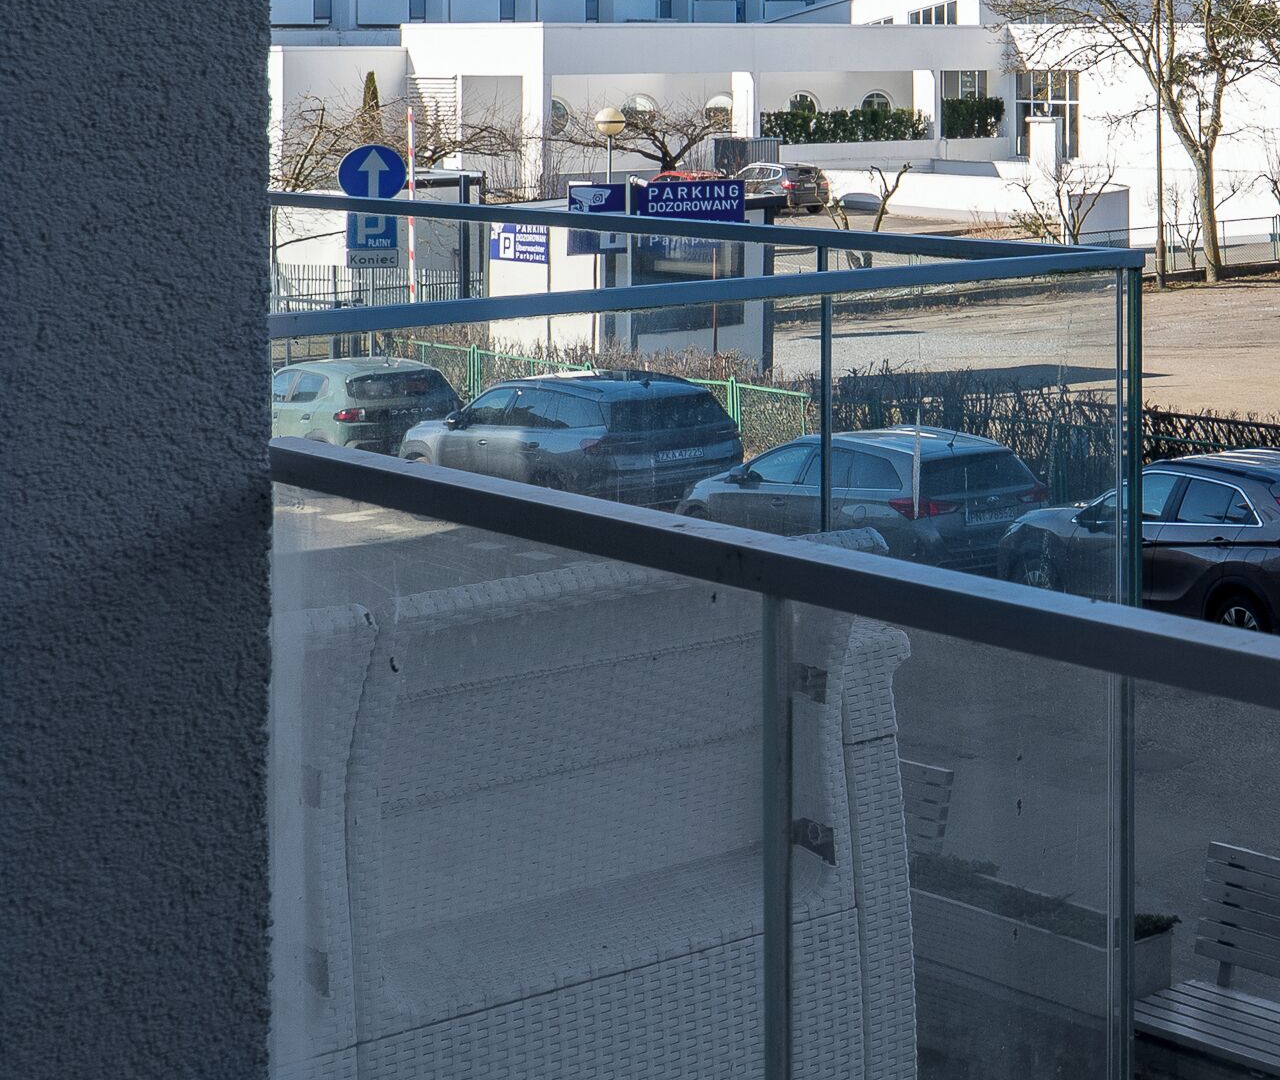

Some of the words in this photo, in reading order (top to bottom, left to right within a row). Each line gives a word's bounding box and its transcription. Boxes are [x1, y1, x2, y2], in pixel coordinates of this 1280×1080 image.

[648, 185, 739, 200] PARKING
[648, 200, 739, 213] DOZOROWANY
[357, 213, 386, 244] P
[350, 254, 395, 265] Koniec
[391, 407, 432, 416] DACIA
